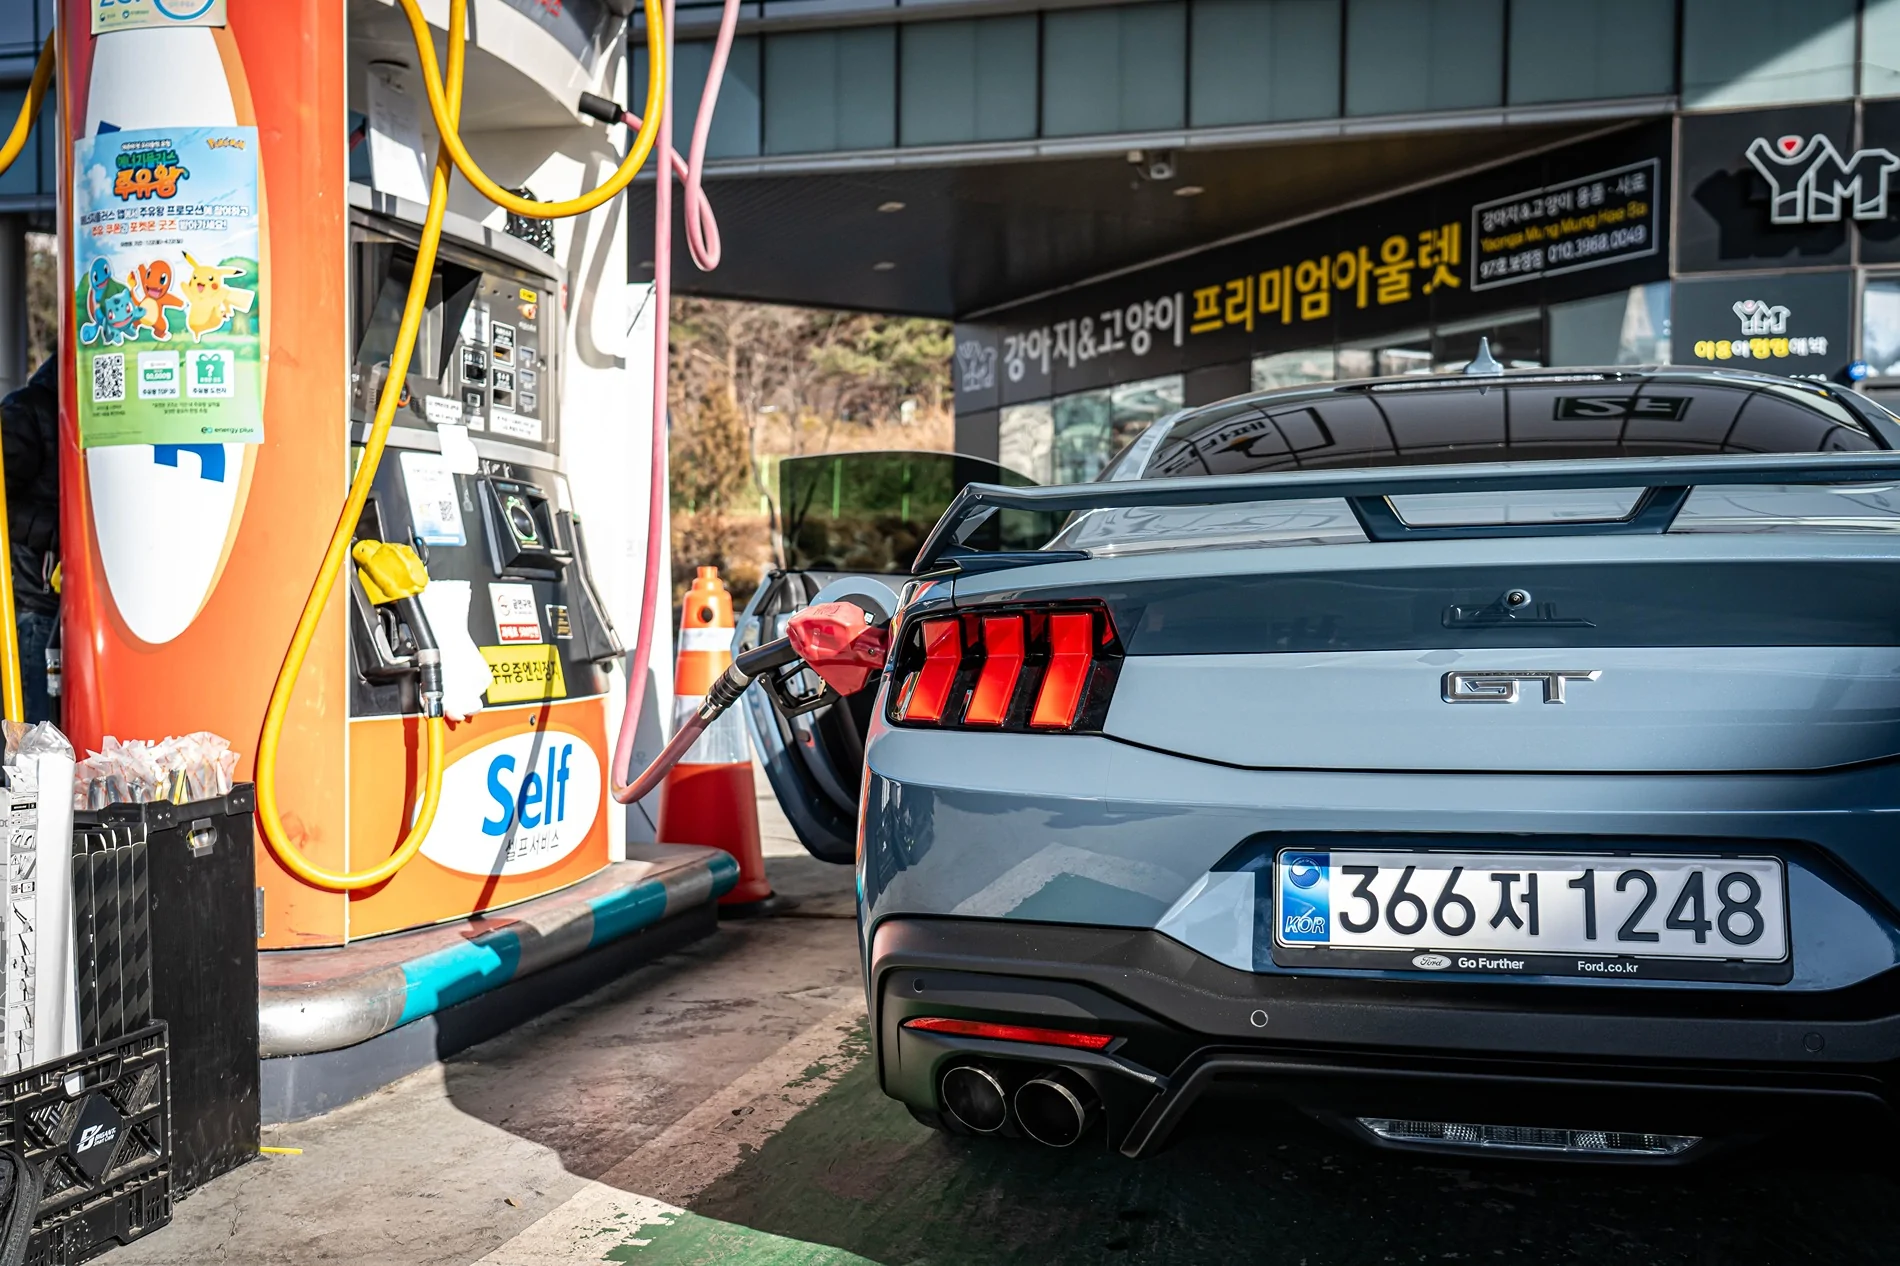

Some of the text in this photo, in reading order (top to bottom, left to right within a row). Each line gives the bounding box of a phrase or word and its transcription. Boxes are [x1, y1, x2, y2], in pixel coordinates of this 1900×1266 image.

[113, 164, 190, 201] 주유왕
[130, 221, 156, 233] 포켓몬
[158, 220, 177, 231] 굿즈
[140, 206, 165, 217] 주유왕
[167, 205, 213, 216] 프로모션에
[1004, 292, 1185, 383] 강아지&고양이
[1441, 670, 1602, 704] GT
[482, 744, 572, 836] Self
[505, 829, 559, 862] 셀프서비스
[1337, 865, 1765, 945] 366저 1248
[1284, 915, 1326, 934] KOR
[1420, 956, 1639, 974] Ford Go Further Ford.co.kr
